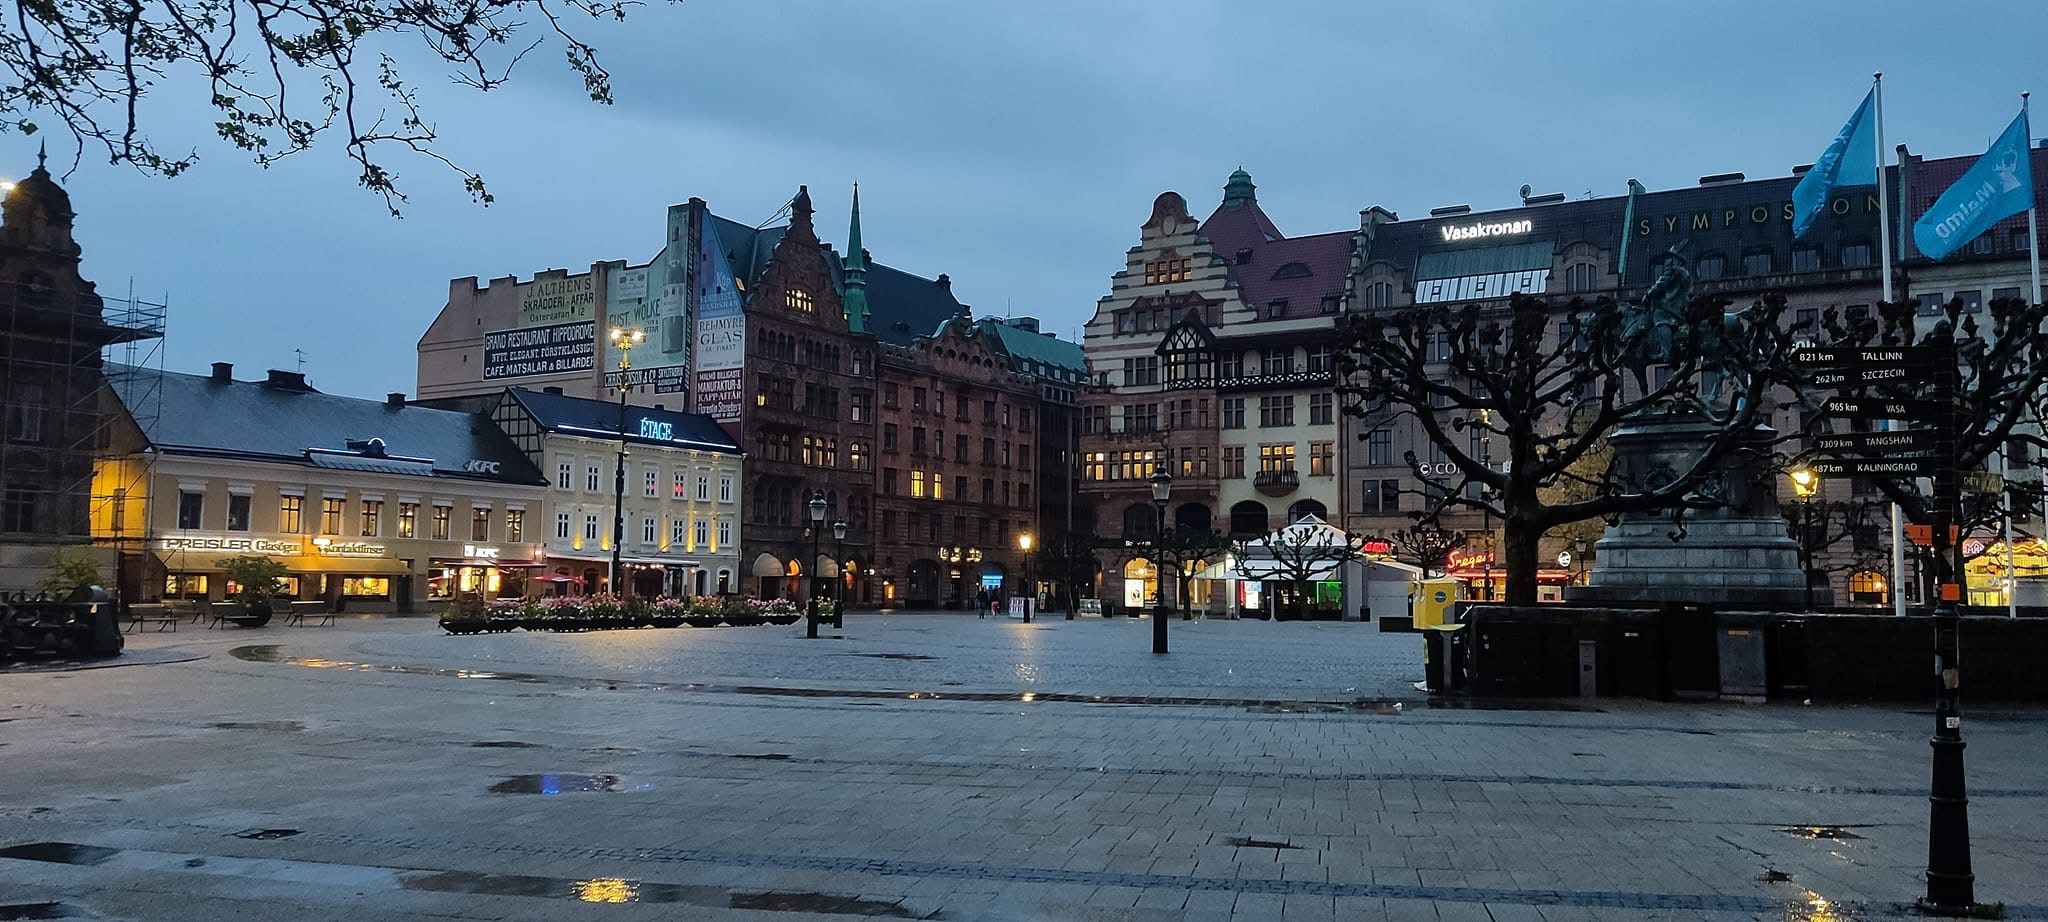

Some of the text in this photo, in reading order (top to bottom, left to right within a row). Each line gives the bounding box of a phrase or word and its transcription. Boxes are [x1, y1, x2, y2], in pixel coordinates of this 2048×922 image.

[1640, 194, 1881, 235] SYMPOSON
[1441, 219, 1532, 241] Vasakronan
[633, 298, 661, 320] WOLKE
[699, 316, 744, 331] REIJMYRE
[485, 324, 595, 351] GRAND RESTAURANT HIPPODROME
[700, 330, 742, 345] GLAS
[1799, 352, 1903, 361] 821 km TALLINN
[506, 361, 547, 375] MATSALAR
[548, 362, 555, 371] &
[1815, 368, 1905, 384] 262 km SZCZECIN
[1829, 402, 1906, 414] 965 km VASA
[640, 416, 672, 440] ÉTAGE
[1819, 435, 1913, 448] 7309 km TANGSHAN
[466, 460, 500, 474] KFC
[1829, 464, 1843, 472] km
[1857, 463, 1918, 472] KALININGRAD
[166, 538, 251, 550] PREISLER
